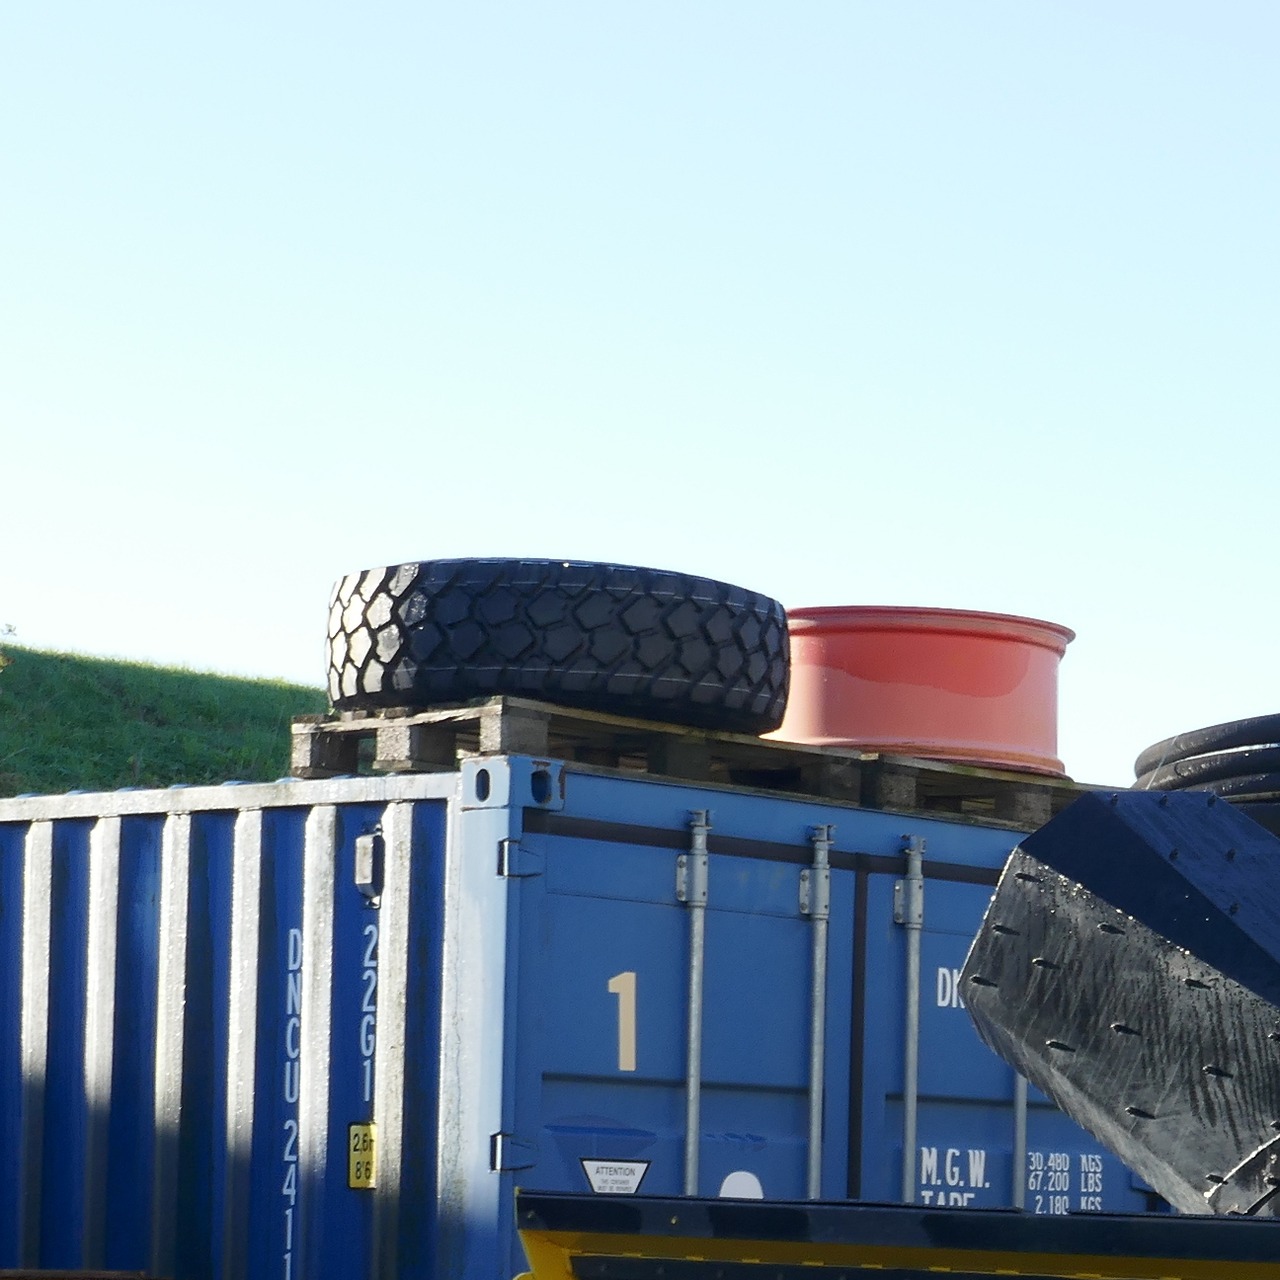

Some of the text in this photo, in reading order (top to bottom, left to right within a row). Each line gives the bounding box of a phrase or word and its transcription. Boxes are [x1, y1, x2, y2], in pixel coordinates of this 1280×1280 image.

[284, 928, 301, 1103] DNCU
[360, 924, 378, 1101] 22G1
[608, 972, 636, 1071] 1
[595, 1166, 636, 1176] ATTENTION
[920, 1147, 990, 1188] M.G.W.
[1080, 1154, 1102, 1172] KGS
[1080, 1173, 1102, 1192] LBS
[1080, 1196, 1102, 1210] KGS
